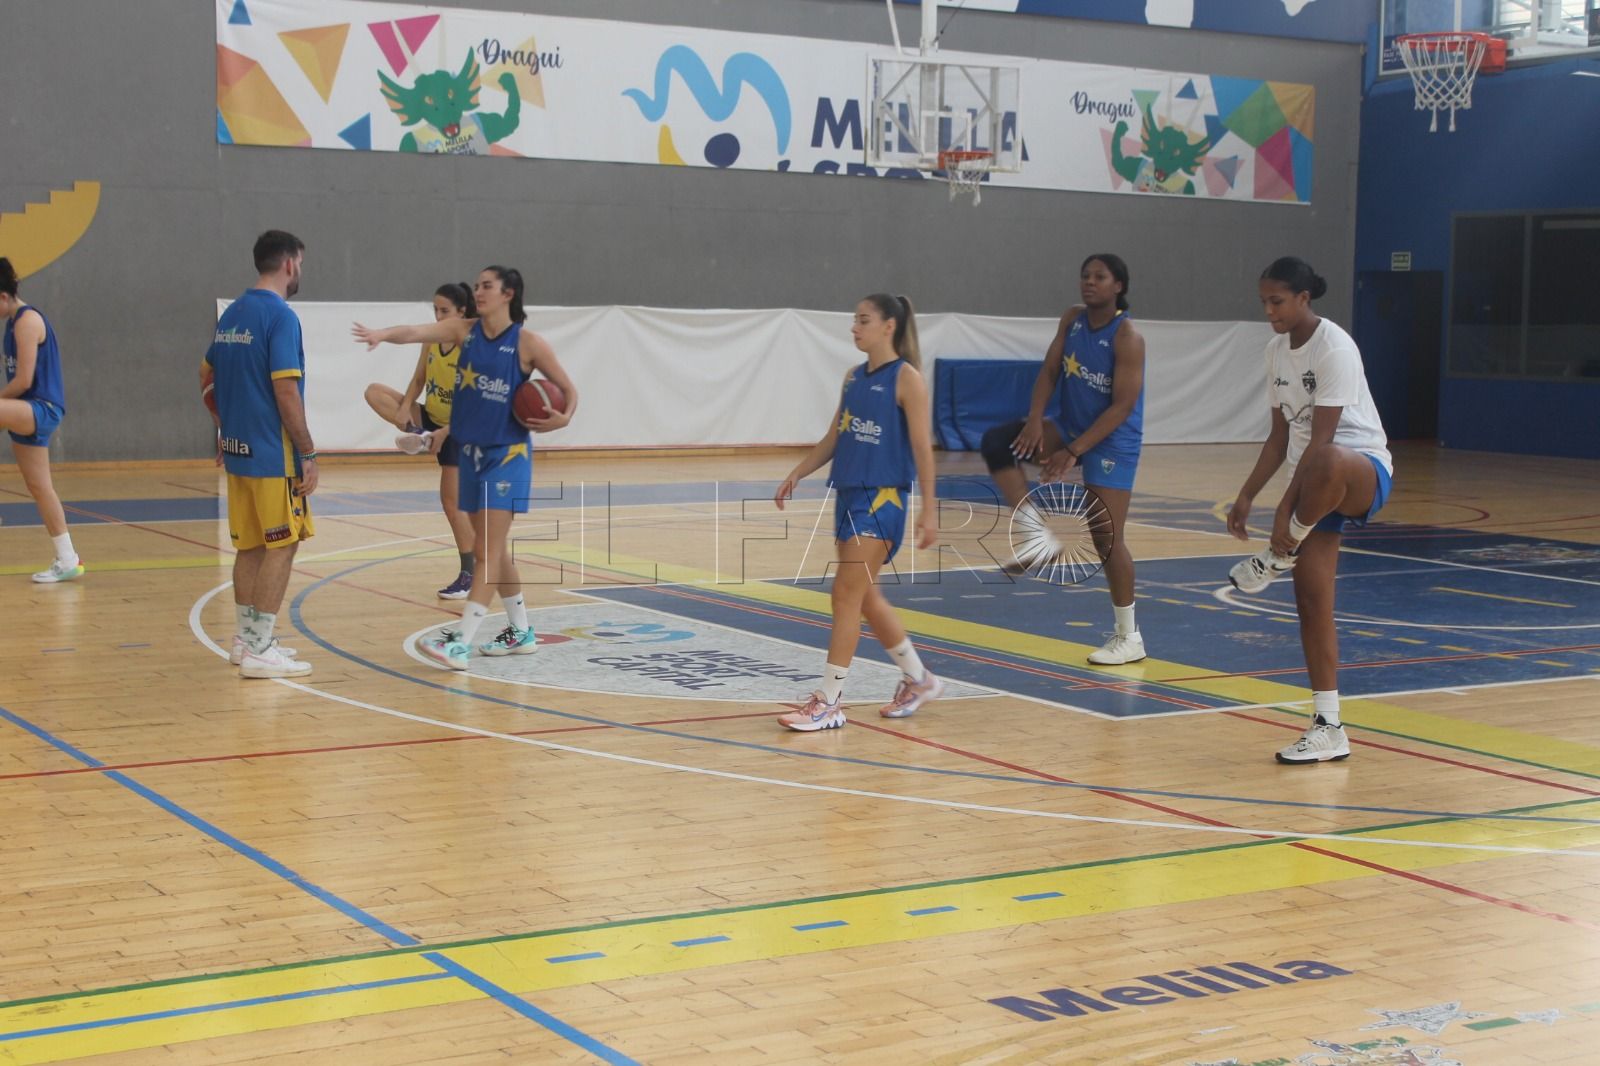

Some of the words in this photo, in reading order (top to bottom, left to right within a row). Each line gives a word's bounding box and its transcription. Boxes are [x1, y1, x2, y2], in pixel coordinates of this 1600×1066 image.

[477, 38, 564, 76] Dragui
[1069, 90, 1136, 124] Dragui
[810, 96, 1031, 162] MELLLA
[478, 374, 511, 395] Salle
[1079, 365, 1113, 386] Salle
[437, 386, 453, 399] Sall
[851, 417, 882, 437] Salle
[221, 437, 250, 455] elilla
[586, 656, 726, 691] CAPITAL
[631, 652, 762, 679] SPORT
[678, 649, 825, 683] MELILLA
[988, 959, 1354, 1023] Melilla
